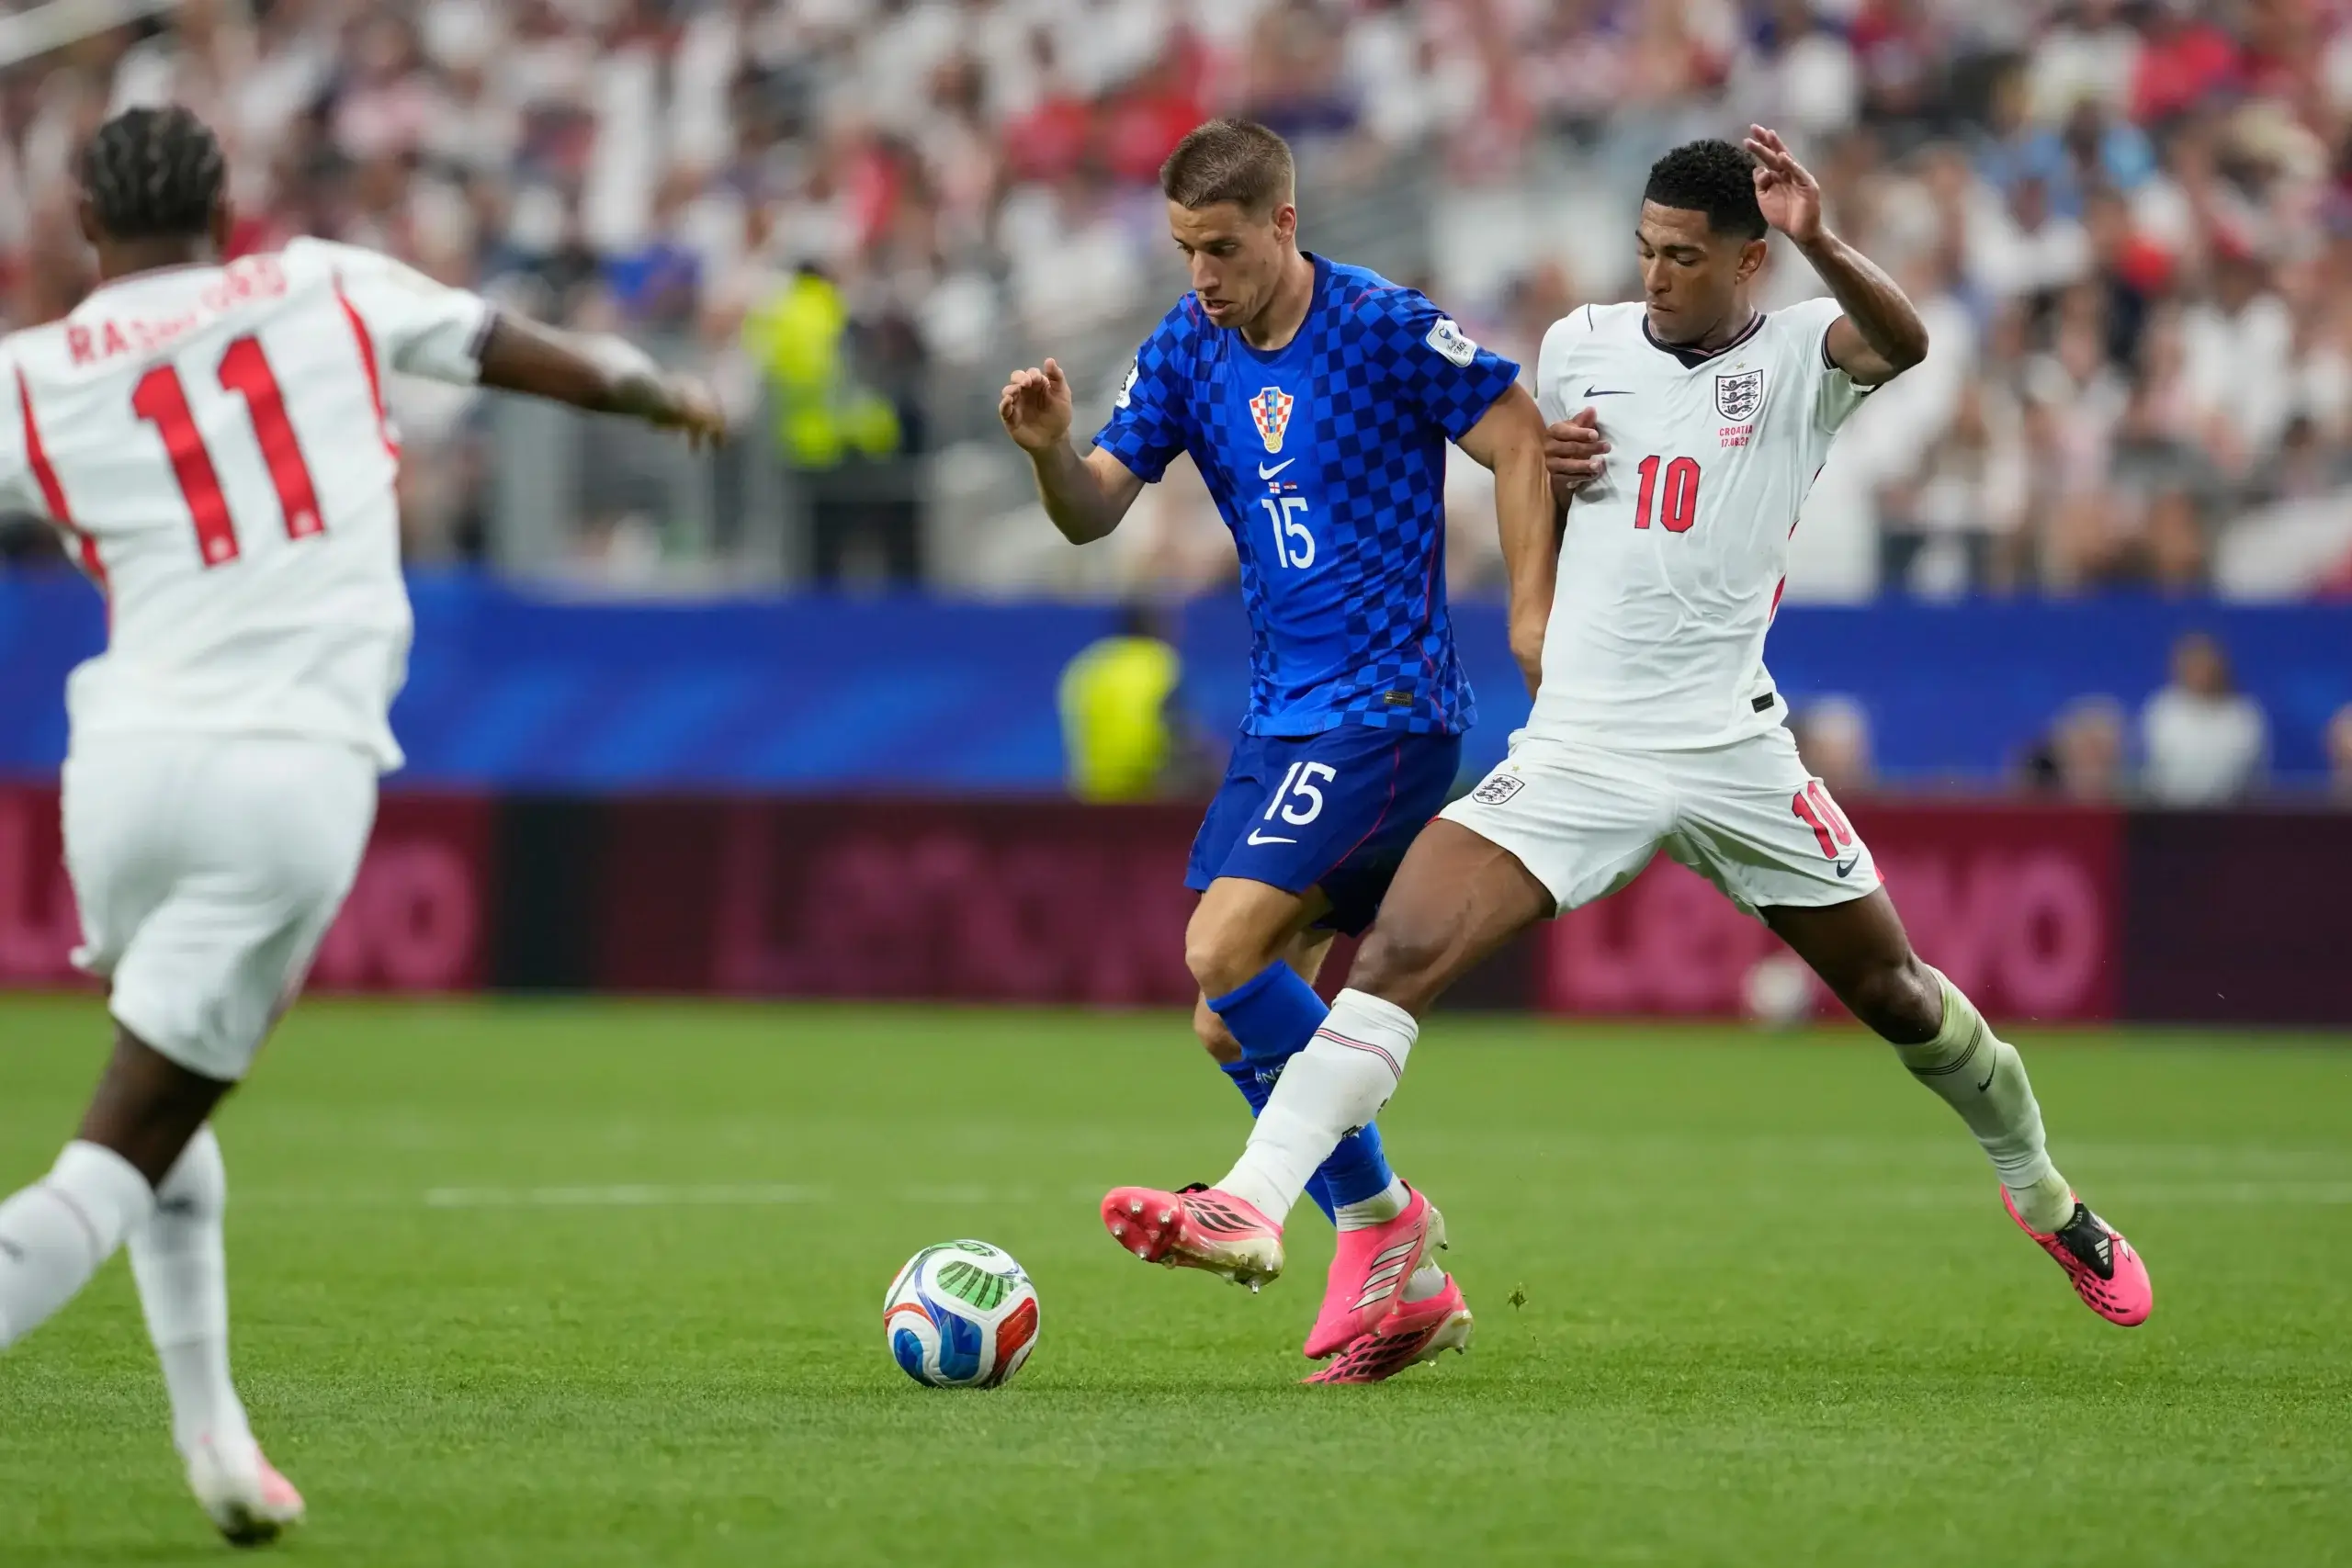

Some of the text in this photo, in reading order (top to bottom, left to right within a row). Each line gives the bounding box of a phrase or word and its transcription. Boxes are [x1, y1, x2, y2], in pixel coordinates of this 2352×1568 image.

[131, 335, 324, 568] 11
[1719, 424, 1753, 436] CROATIA
[1634, 455, 1701, 533] 10
[1261, 497, 1316, 569] 15
[1263, 761, 1337, 826] 15
[1792, 780, 1852, 859] 10
